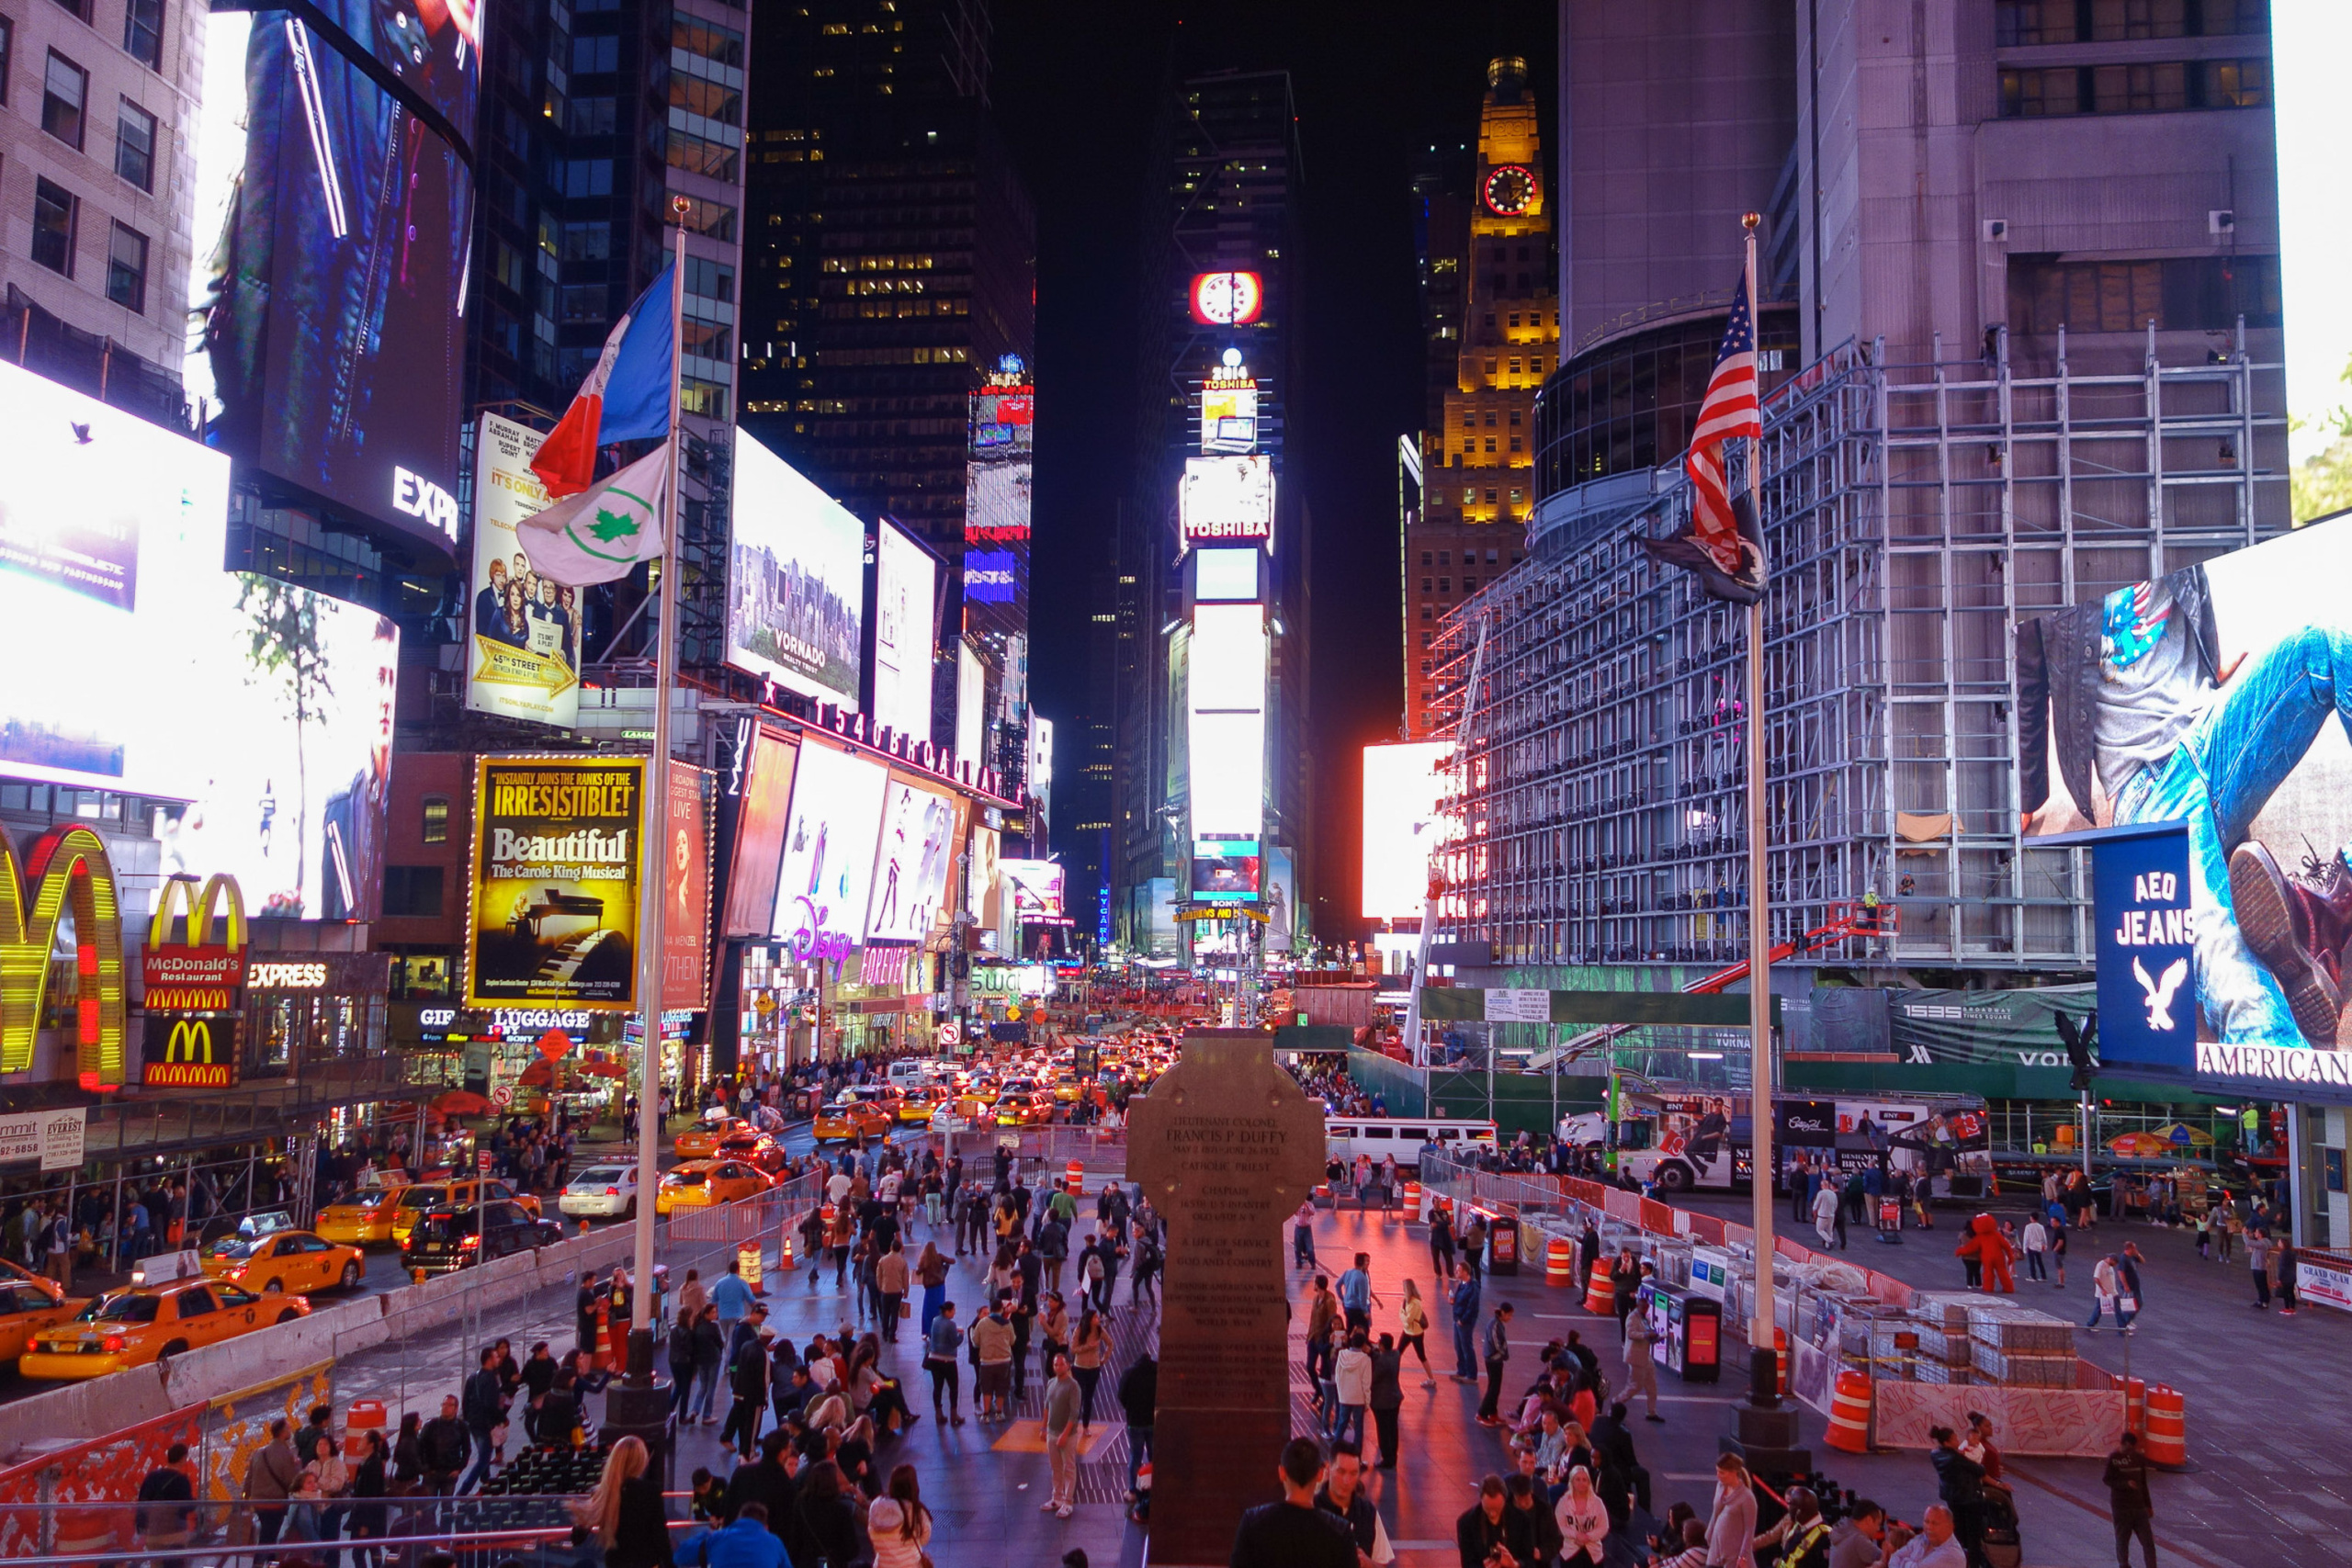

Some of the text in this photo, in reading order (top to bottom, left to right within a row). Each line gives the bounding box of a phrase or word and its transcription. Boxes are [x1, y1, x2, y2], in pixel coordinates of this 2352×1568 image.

[1213, 367, 1248, 380] 2014
[1204, 380, 1256, 389] TOSHIBA
[489, 427, 519, 444] ABRAHAM
[496, 423, 520, 437] MURRAY
[499, 440, 520, 453] RUPERT
[526, 435, 544, 445] MATT
[501, 447, 518, 458] GRINT
[492, 471, 513, 490] IT'S
[514, 479, 542, 500] ONLY
[490, 518, 516, 532] TELECHA
[1187, 522, 1268, 537] TOSHIBA
[775, 627, 826, 668] VORNADO
[493, 654, 541, 672] 45TH STREET
[783, 652, 818, 674] REALTY TRUST
[536, 773, 559, 785] JOINS
[560, 773, 574, 785] THE
[576, 773, 603, 785] RANKS
[605, 773, 616, 785] OF
[616, 773, 631, 785] THE
[688, 790, 702, 802] STAR
[673, 801, 691, 819] LIVE
[492, 828, 628, 863] Beautiful
[492, 864, 627, 882] The Carole King Musical
[2135, 872, 2177, 904] AEO
[2116, 908, 2196, 946] JEANS
[675, 935, 696, 947] MENZEL
[147, 957, 239, 972] McDonald's
[859, 946, 909, 986] FOREVER
[161, 973, 222, 982] Restaurant
[247, 963, 327, 989] EXPRESS
[1904, 1005, 1962, 1019] 1535
[493, 1010, 590, 1029] LUGGAGE
[1716, 1032, 1751, 1049] VORNA
[2201, 1045, 2352, 1086] AMERICAN
[48, 1122, 83, 1134] EVEREST
[1174, 1117, 1277, 1128] LIEUTENANT COLONEL
[1167, 1130, 1288, 1145] FRANCIS P DUFFY
[1172, 1145, 1191, 1154] MAY
[1225, 1146, 1246, 1155] JUNE
[1182, 1162, 1272, 1172] CATHOLIC PRIEST
[1202, 1187, 1250, 1195] CHAPLAIN
[1228, 1201, 1272, 1210] INFANTRY
[1193, 1239, 1211, 1247] LIFE
[1215, 1239, 1228, 1247] OF
[1233, 1238, 1271, 1247] SERVICE
[1177, 1258, 1273, 1269] GOD AND COUNTRY
[2304, 1267, 2349, 1284] GRAND SLAM
